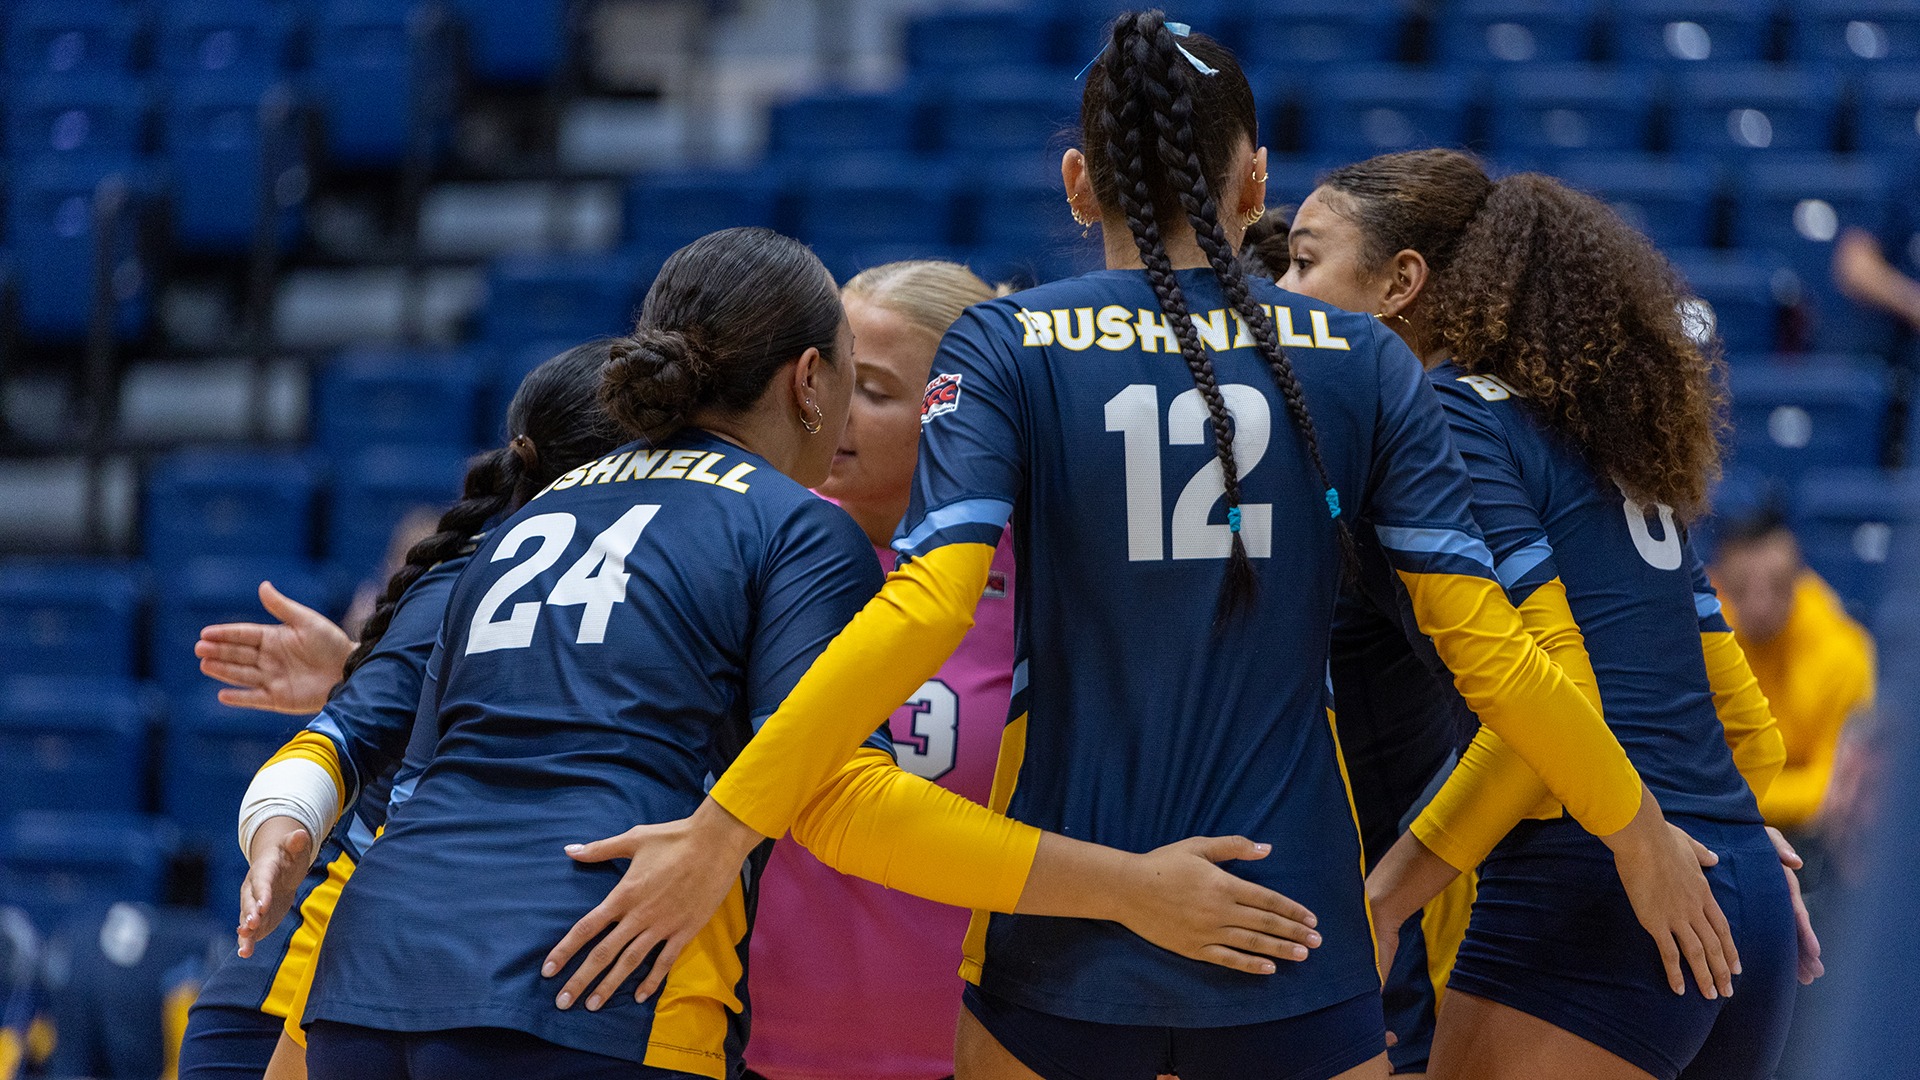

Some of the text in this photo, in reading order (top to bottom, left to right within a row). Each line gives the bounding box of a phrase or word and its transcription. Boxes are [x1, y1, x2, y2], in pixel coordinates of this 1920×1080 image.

[531, 449, 758, 501] SHNELL
[1104, 383, 1273, 562] 12
[464, 504, 662, 657] 24
